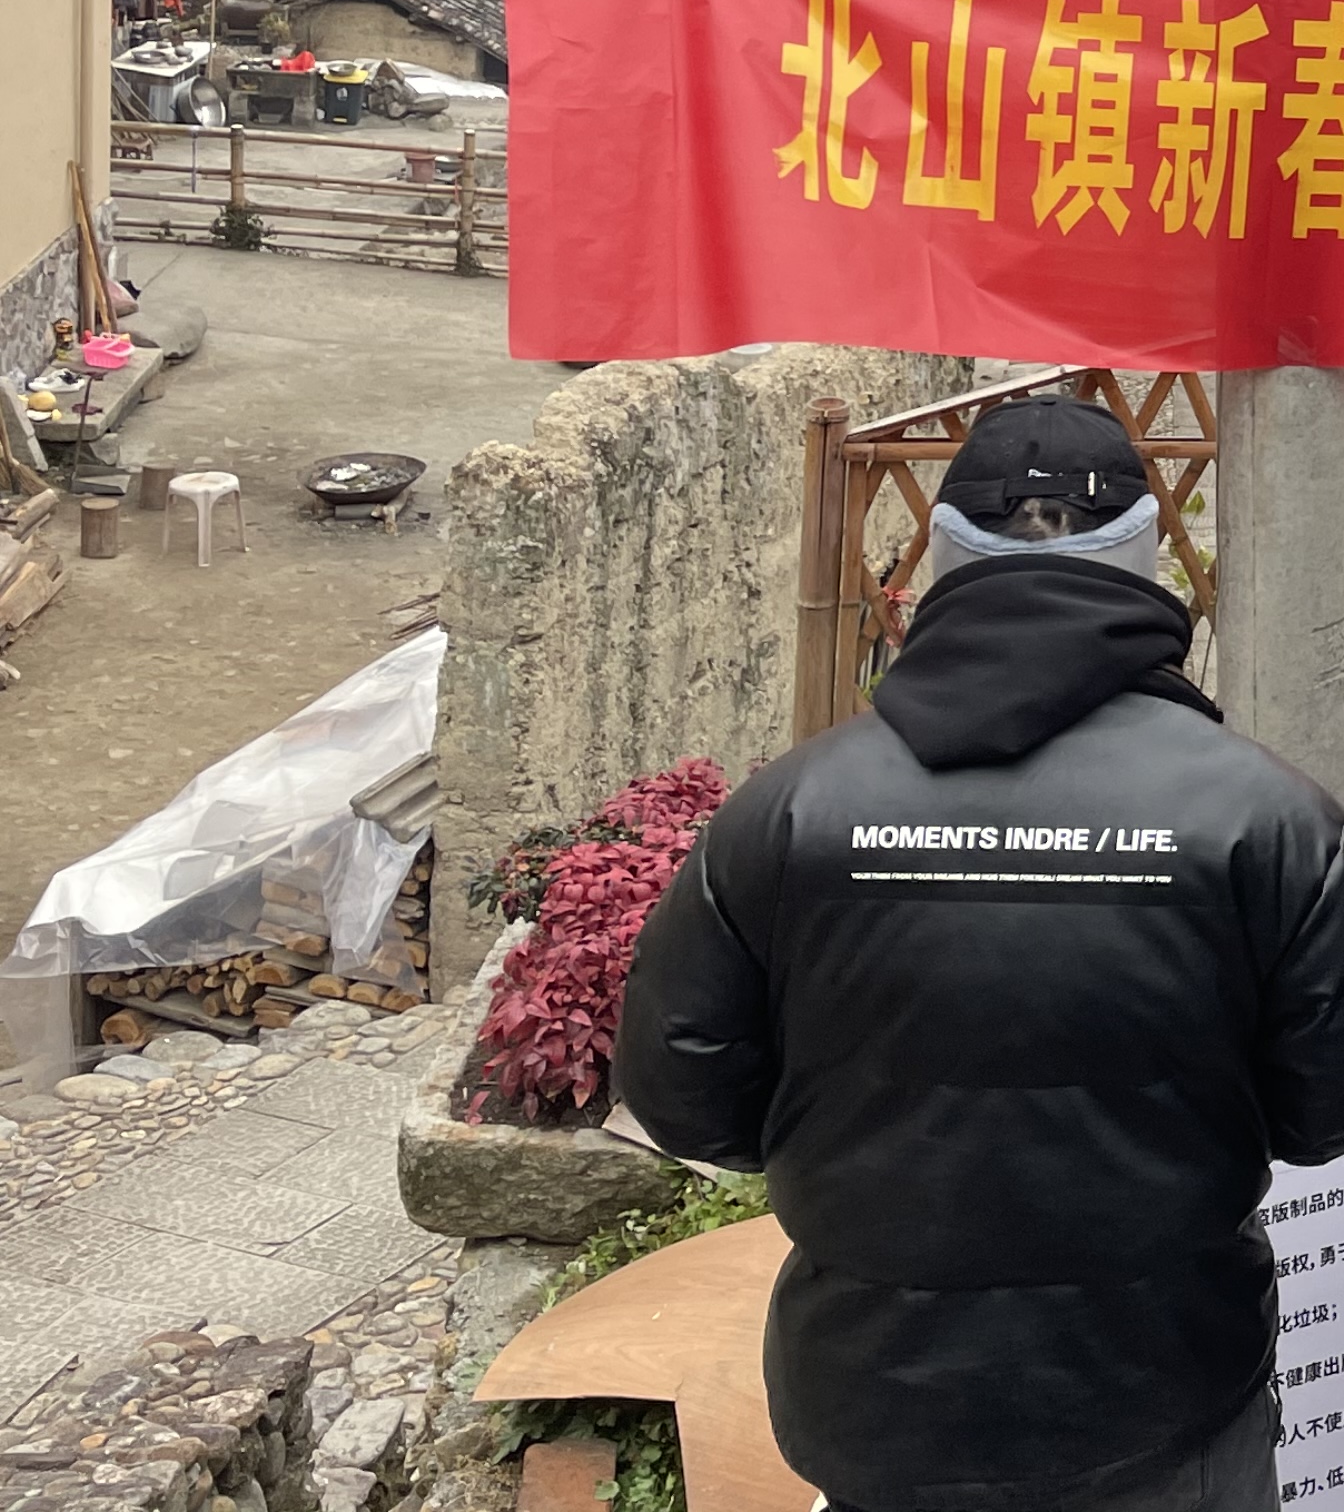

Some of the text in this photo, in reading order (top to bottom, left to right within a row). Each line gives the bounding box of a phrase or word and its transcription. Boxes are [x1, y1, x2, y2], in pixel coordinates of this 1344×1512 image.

[851, 826, 999, 850] MOMENTS
[1004, 827, 1090, 851] INDRE
[1115, 829, 1178, 853] LIFE.
